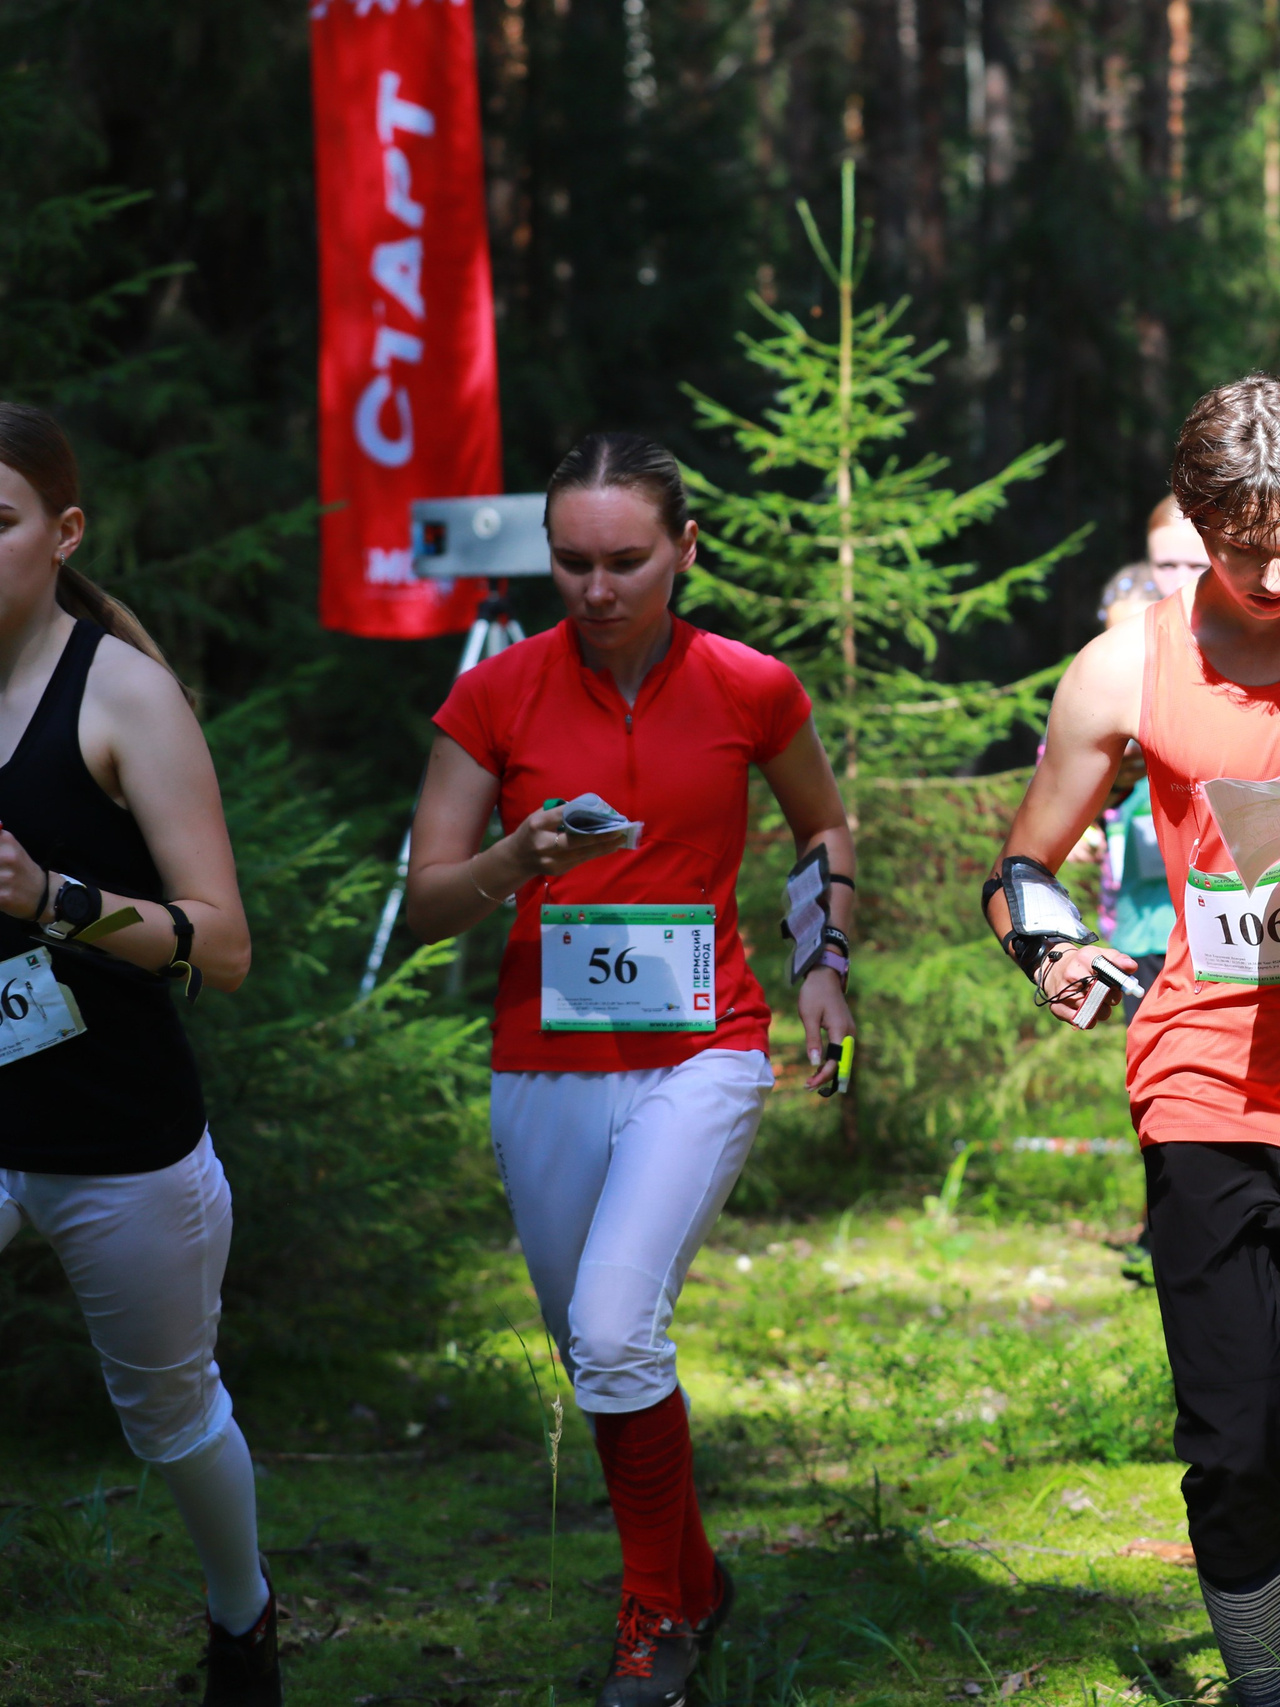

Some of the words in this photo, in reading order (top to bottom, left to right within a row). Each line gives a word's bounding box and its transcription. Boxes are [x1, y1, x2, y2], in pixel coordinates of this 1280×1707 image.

[352, 69, 437, 468] СТАРТ
[588, 946, 638, 985] 56
[691, 929, 701, 988] ПЕРМСКИЙ
[702, 943, 711, 988] ПЕРИОД
[0, 977, 29, 1028] 6
